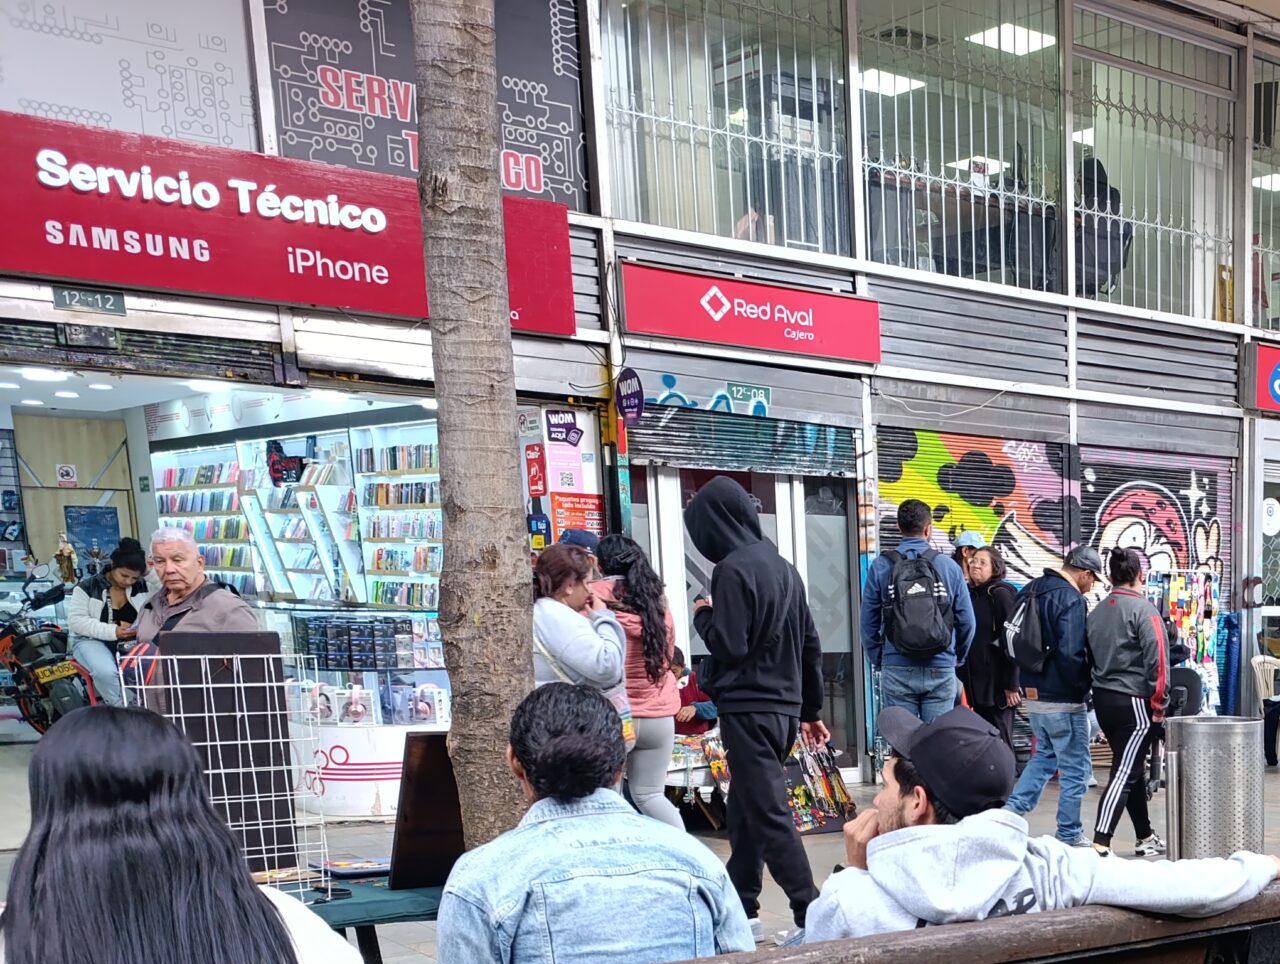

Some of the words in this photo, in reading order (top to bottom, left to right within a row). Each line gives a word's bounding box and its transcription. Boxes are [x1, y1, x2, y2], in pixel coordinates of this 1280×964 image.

[316, 65, 418, 124] SERV
[35, 148, 221, 210] Servicio
[227, 177, 387, 234] Técnico
[44, 220, 211, 262] SAMSUNG
[286, 247, 390, 286] iPhone
[733, 298, 771, 321] Red
[774, 303, 814, 327] Aval
[783, 327, 815, 341] Cajero
[618, 376, 641, 397] WOM
[548, 413, 575, 425] WOM
